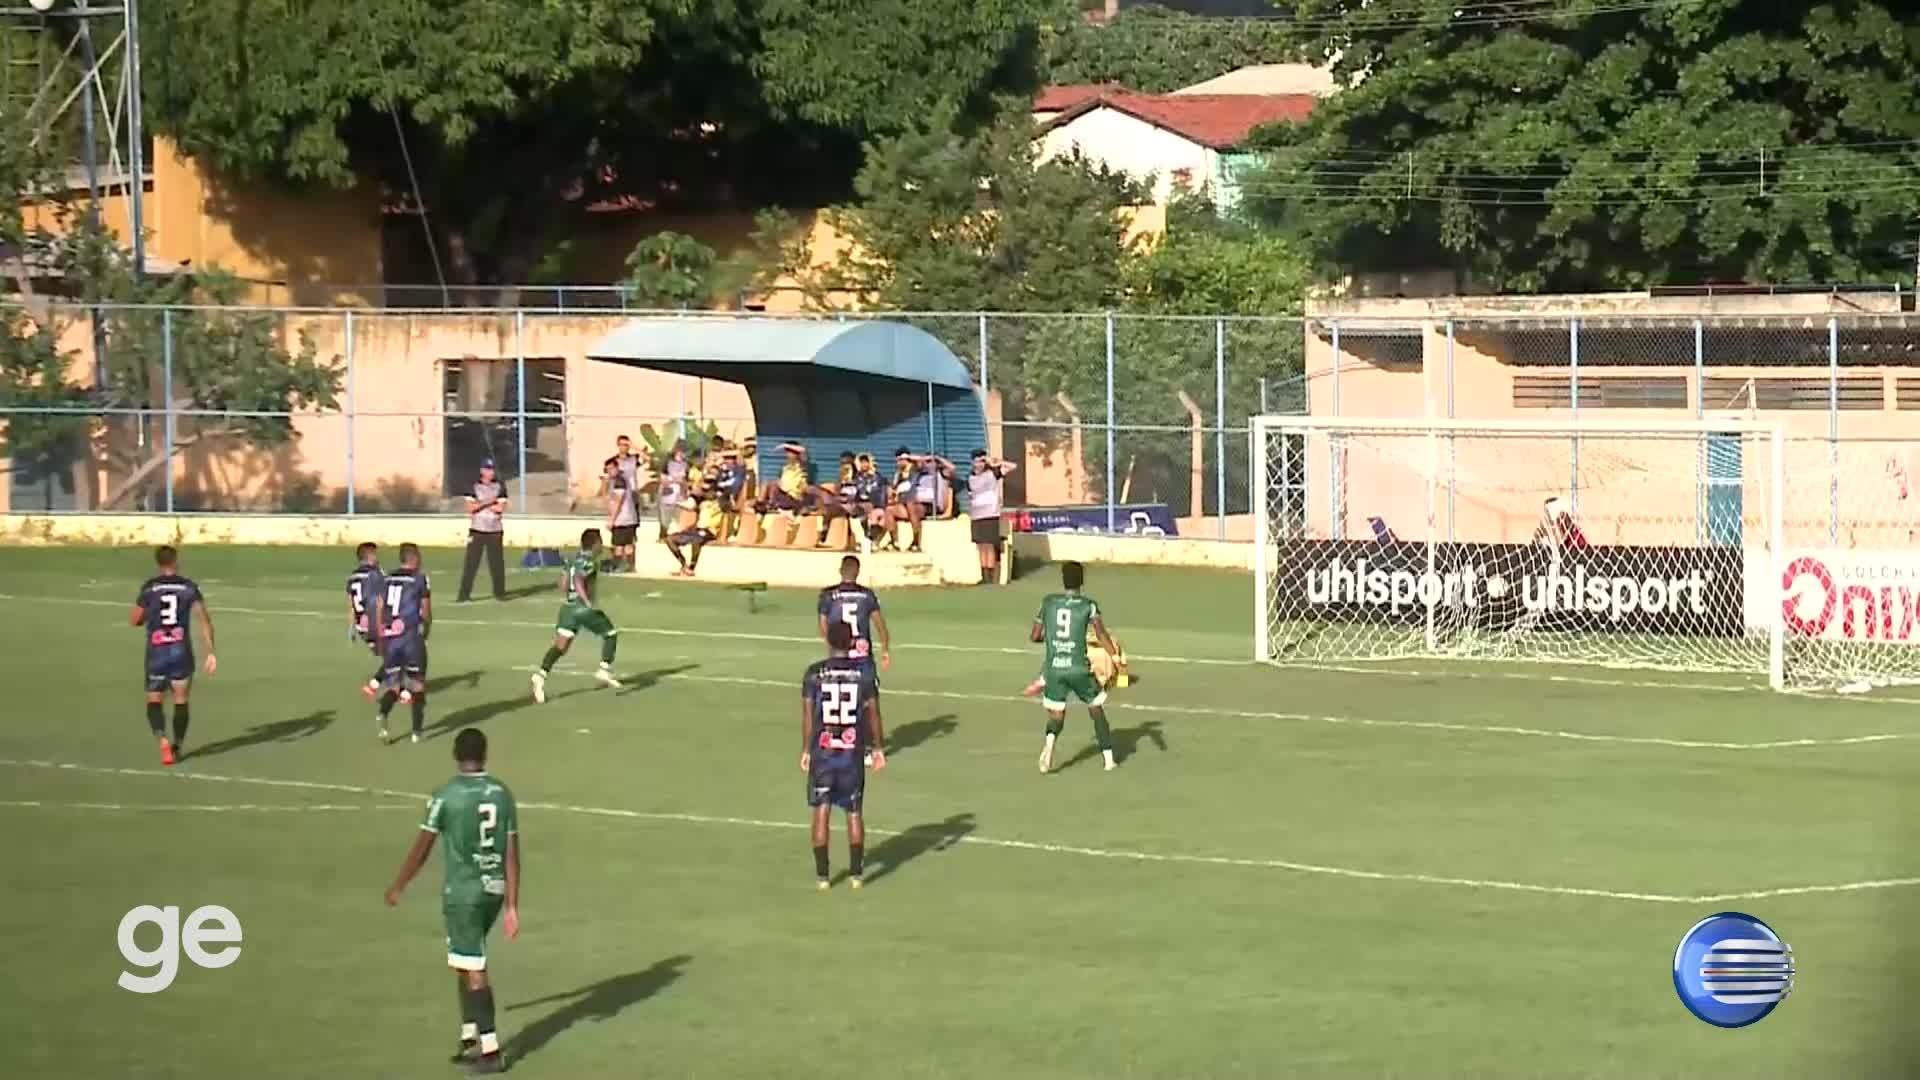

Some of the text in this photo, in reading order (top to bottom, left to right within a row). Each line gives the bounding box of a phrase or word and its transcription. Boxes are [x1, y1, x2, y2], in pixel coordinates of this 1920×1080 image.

[351, 582, 364, 612] 2
[387, 585, 403, 616] 4
[1306, 557, 1705, 622] uhlsport uhlsport
[160, 595, 177, 625] 3
[841, 602, 859, 636] 5
[1056, 608, 1071, 637] 9
[821, 683, 858, 724] 22
[478, 803, 497, 847] 2
